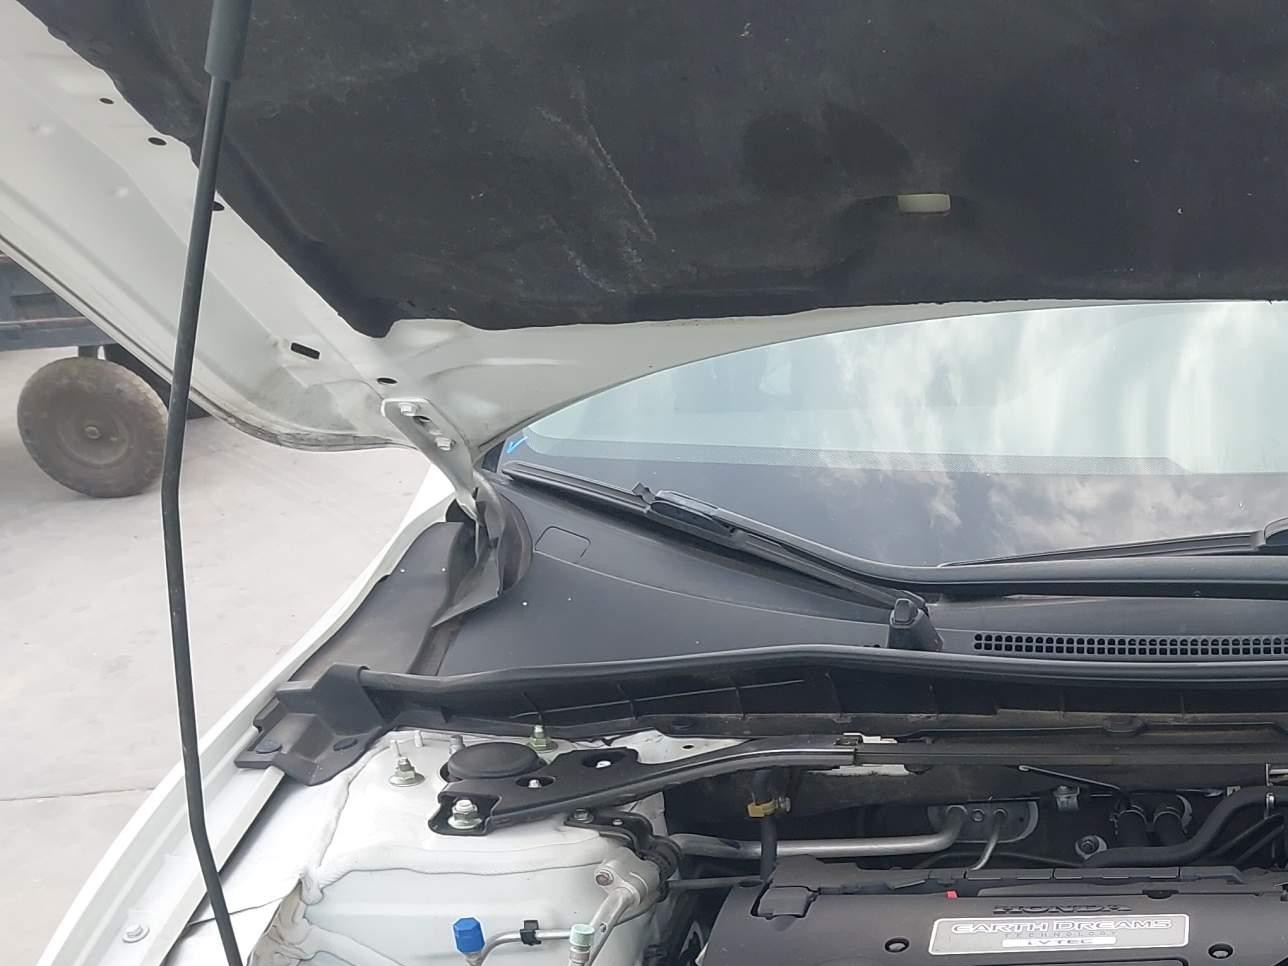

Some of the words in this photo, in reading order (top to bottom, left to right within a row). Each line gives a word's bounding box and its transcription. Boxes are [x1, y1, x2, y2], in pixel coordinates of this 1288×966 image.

[993, 904, 1132, 915] HONDA
[951, 921, 1049, 934] EARTH
[1053, 919, 1174, 931] DREAMS
